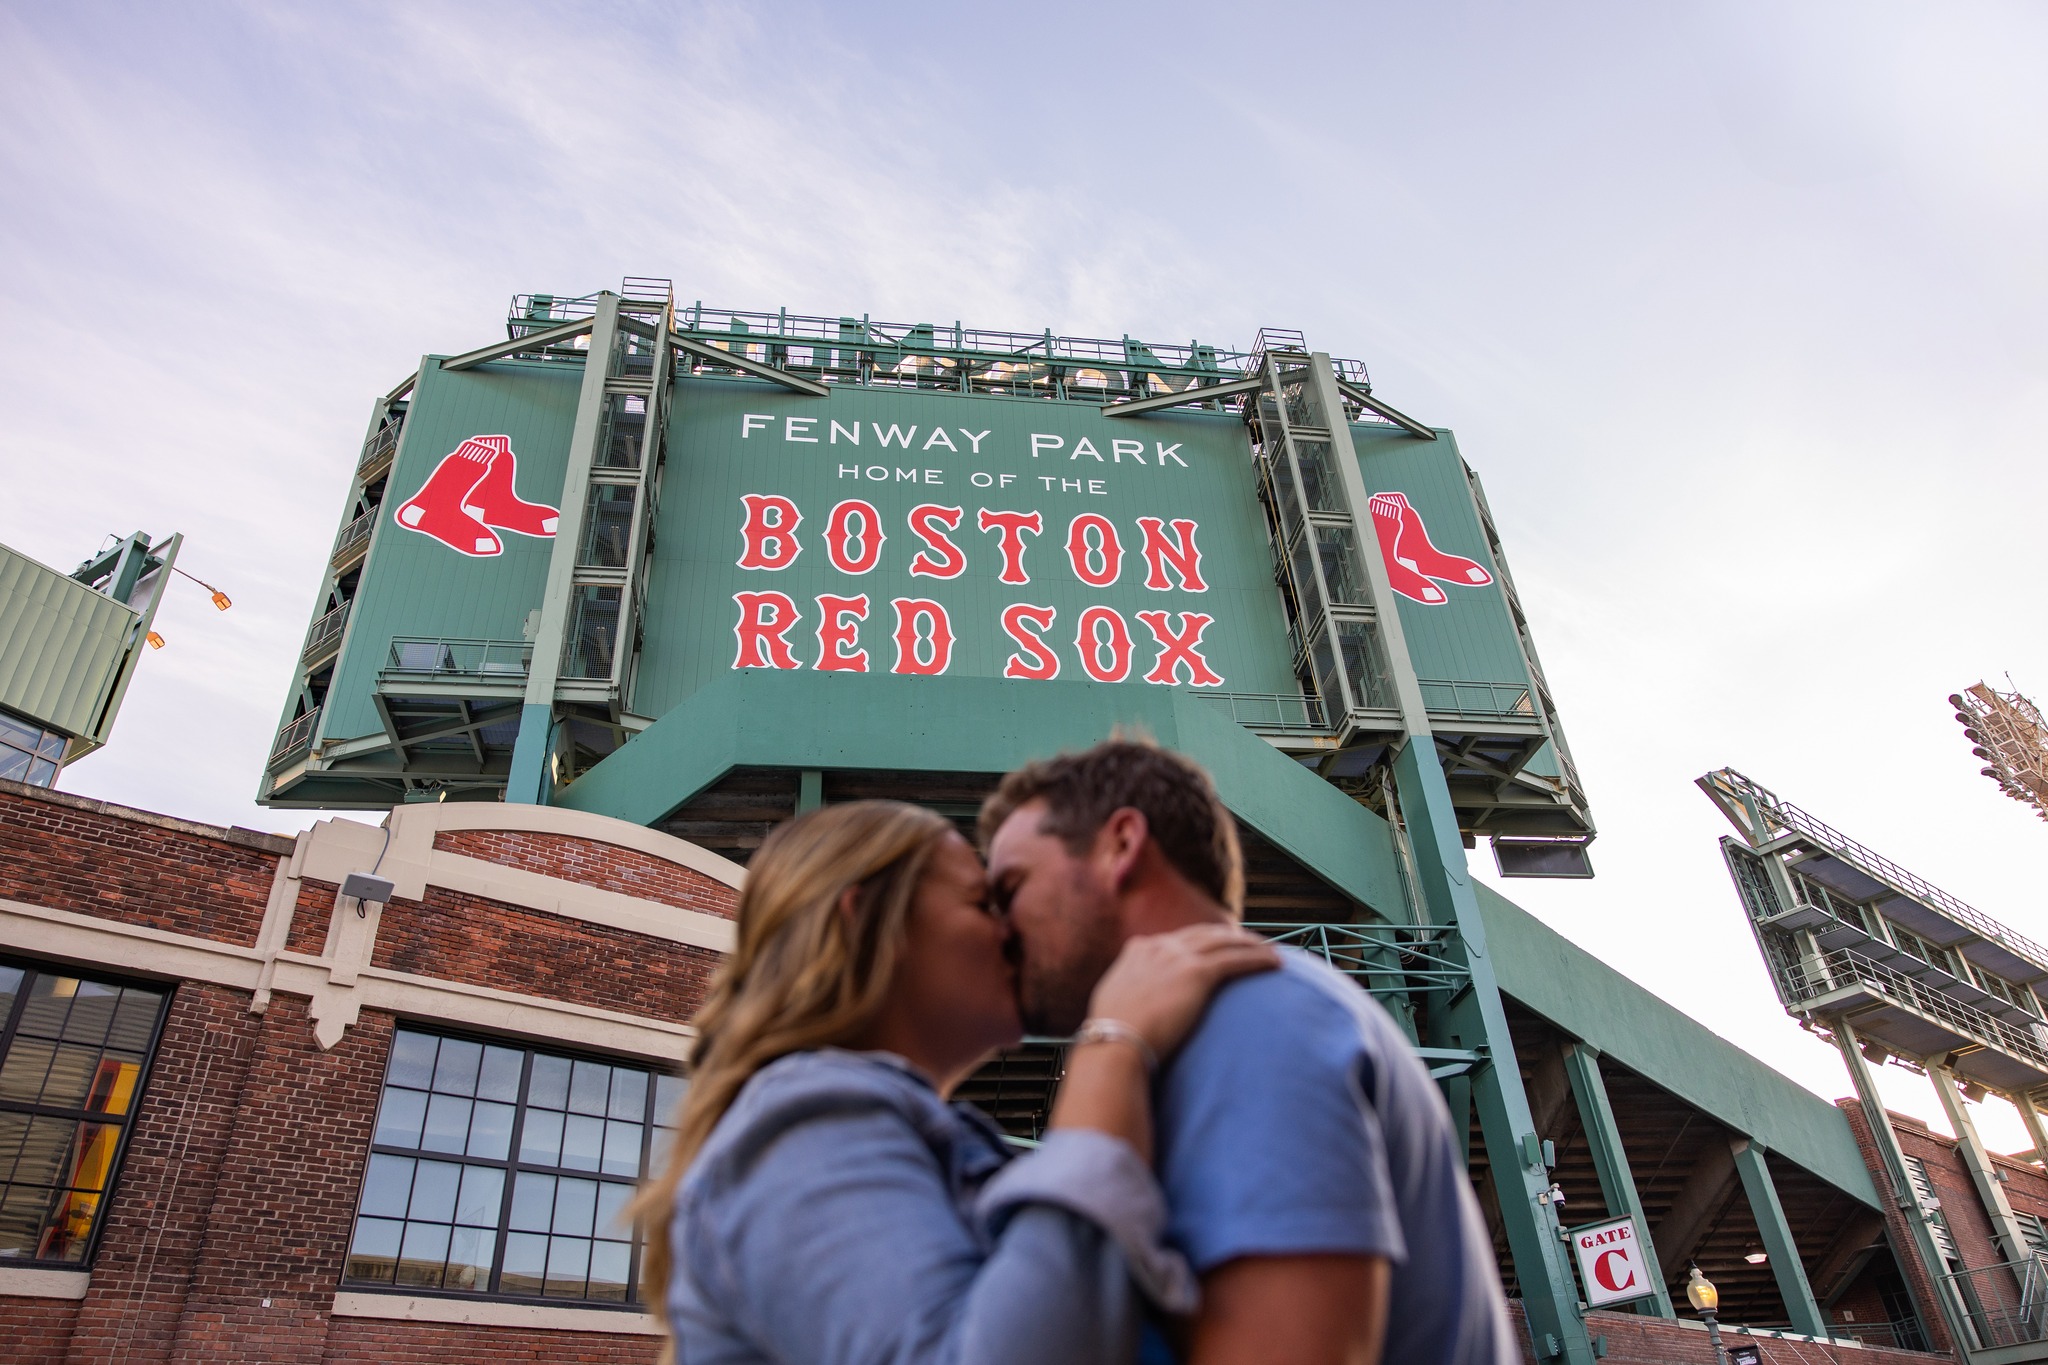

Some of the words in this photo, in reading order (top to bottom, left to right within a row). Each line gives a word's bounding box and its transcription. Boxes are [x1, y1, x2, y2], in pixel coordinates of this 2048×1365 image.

[742, 414, 991, 453] FENWAY
[1031, 433, 1188, 467] PARK
[838, 464, 944, 484] HOME
[970, 472, 1017, 488] OF
[1038, 477, 1108, 495] THE
[735, 493, 1210, 593] BOSTON
[731, 590, 957, 675] RED
[1001, 603, 1226, 687] SOX
[1580, 1226, 1631, 1249] GATE
[1594, 1247, 1636, 1291] C
